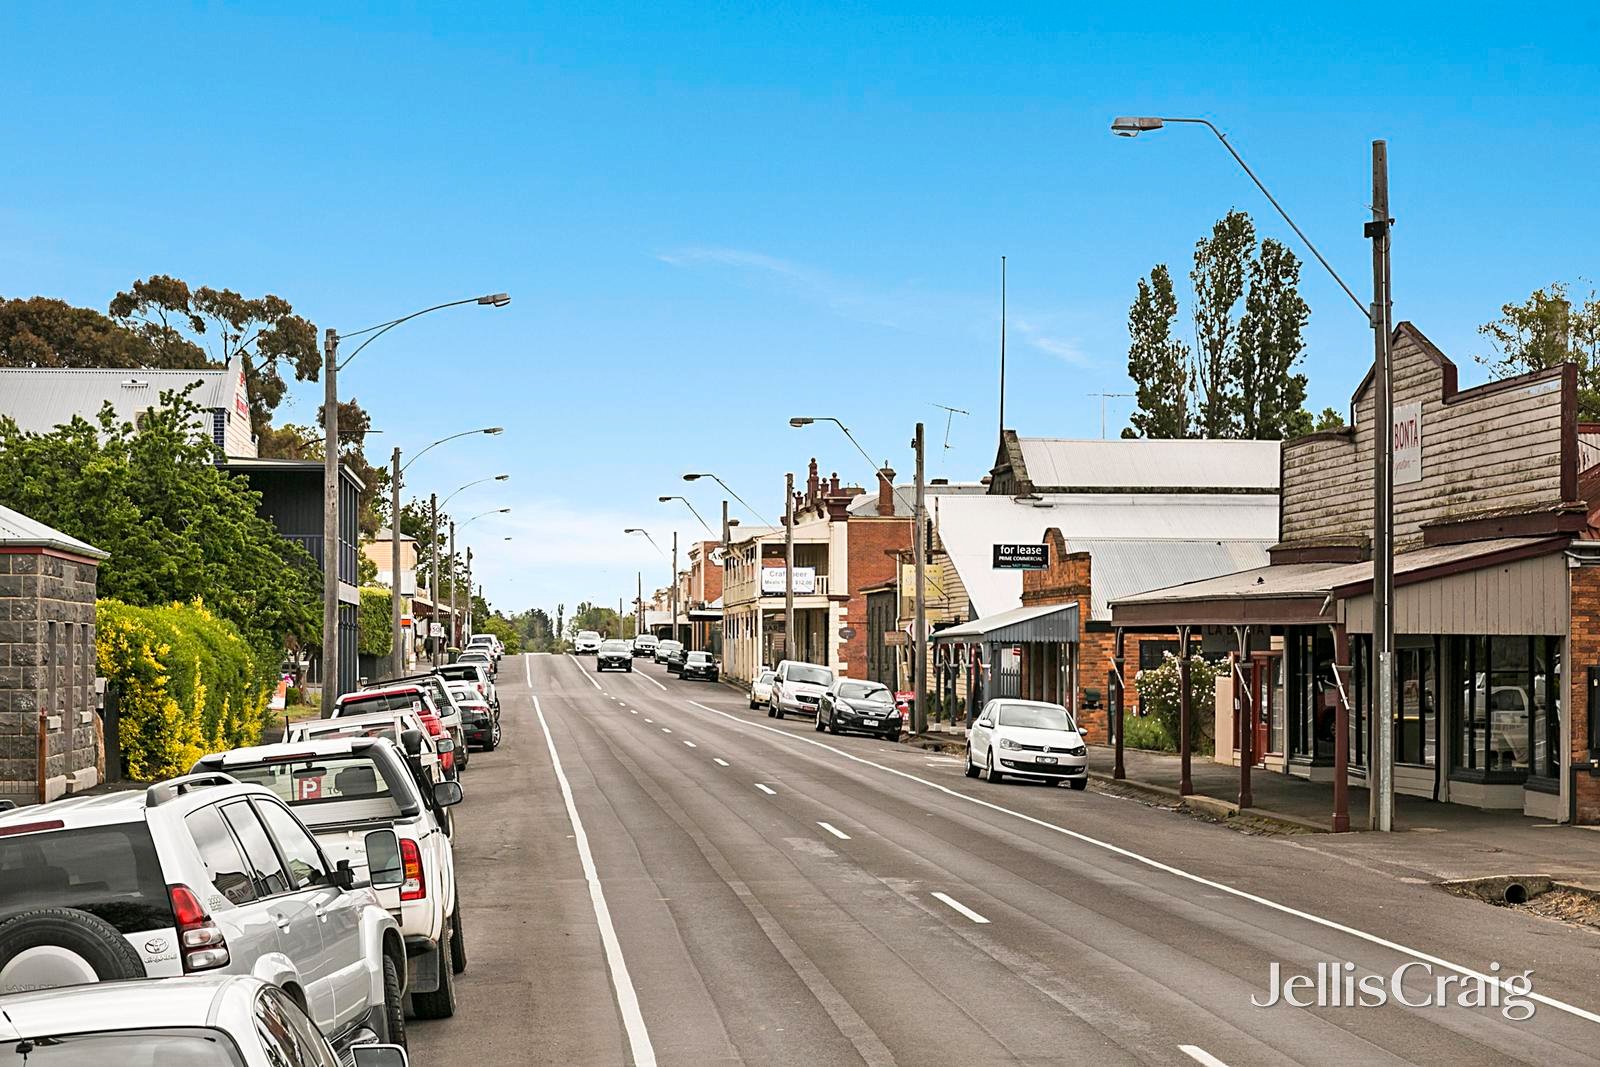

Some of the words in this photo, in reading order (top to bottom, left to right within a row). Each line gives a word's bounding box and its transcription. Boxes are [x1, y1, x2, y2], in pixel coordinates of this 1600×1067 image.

[1000, 545, 1015, 555] for
[1017, 545, 1042, 555] lease
[302, 780, 317, 799] P
